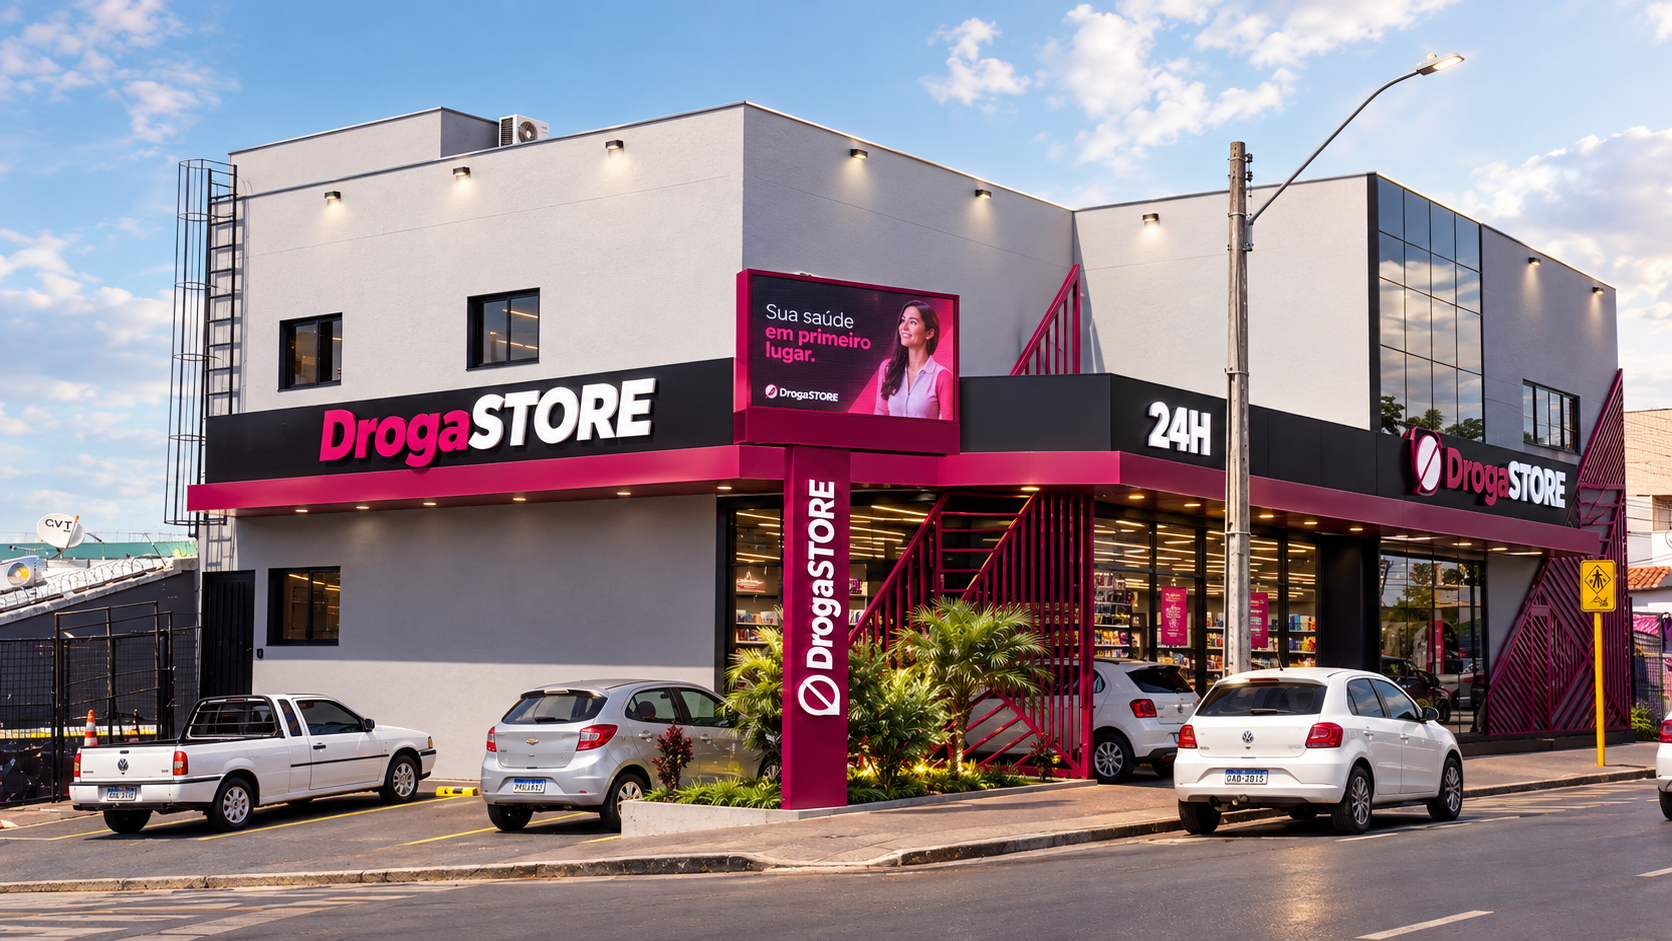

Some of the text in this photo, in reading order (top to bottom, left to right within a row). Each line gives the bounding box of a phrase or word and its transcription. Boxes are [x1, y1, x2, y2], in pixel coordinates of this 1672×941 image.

[766, 303, 854, 329] Sua saúde
[765, 326, 871, 350] em primeiro
[765, 341, 815, 363] lugar.
[779, 387, 838, 402] DrogaSTORE
[319, 378, 657, 468] DrogaSTORE
[1148, 401, 1212, 456] 24H
[1445, 446, 1567, 508] DrogaSTORE
[806, 479, 842, 670] DrogaSTORE
